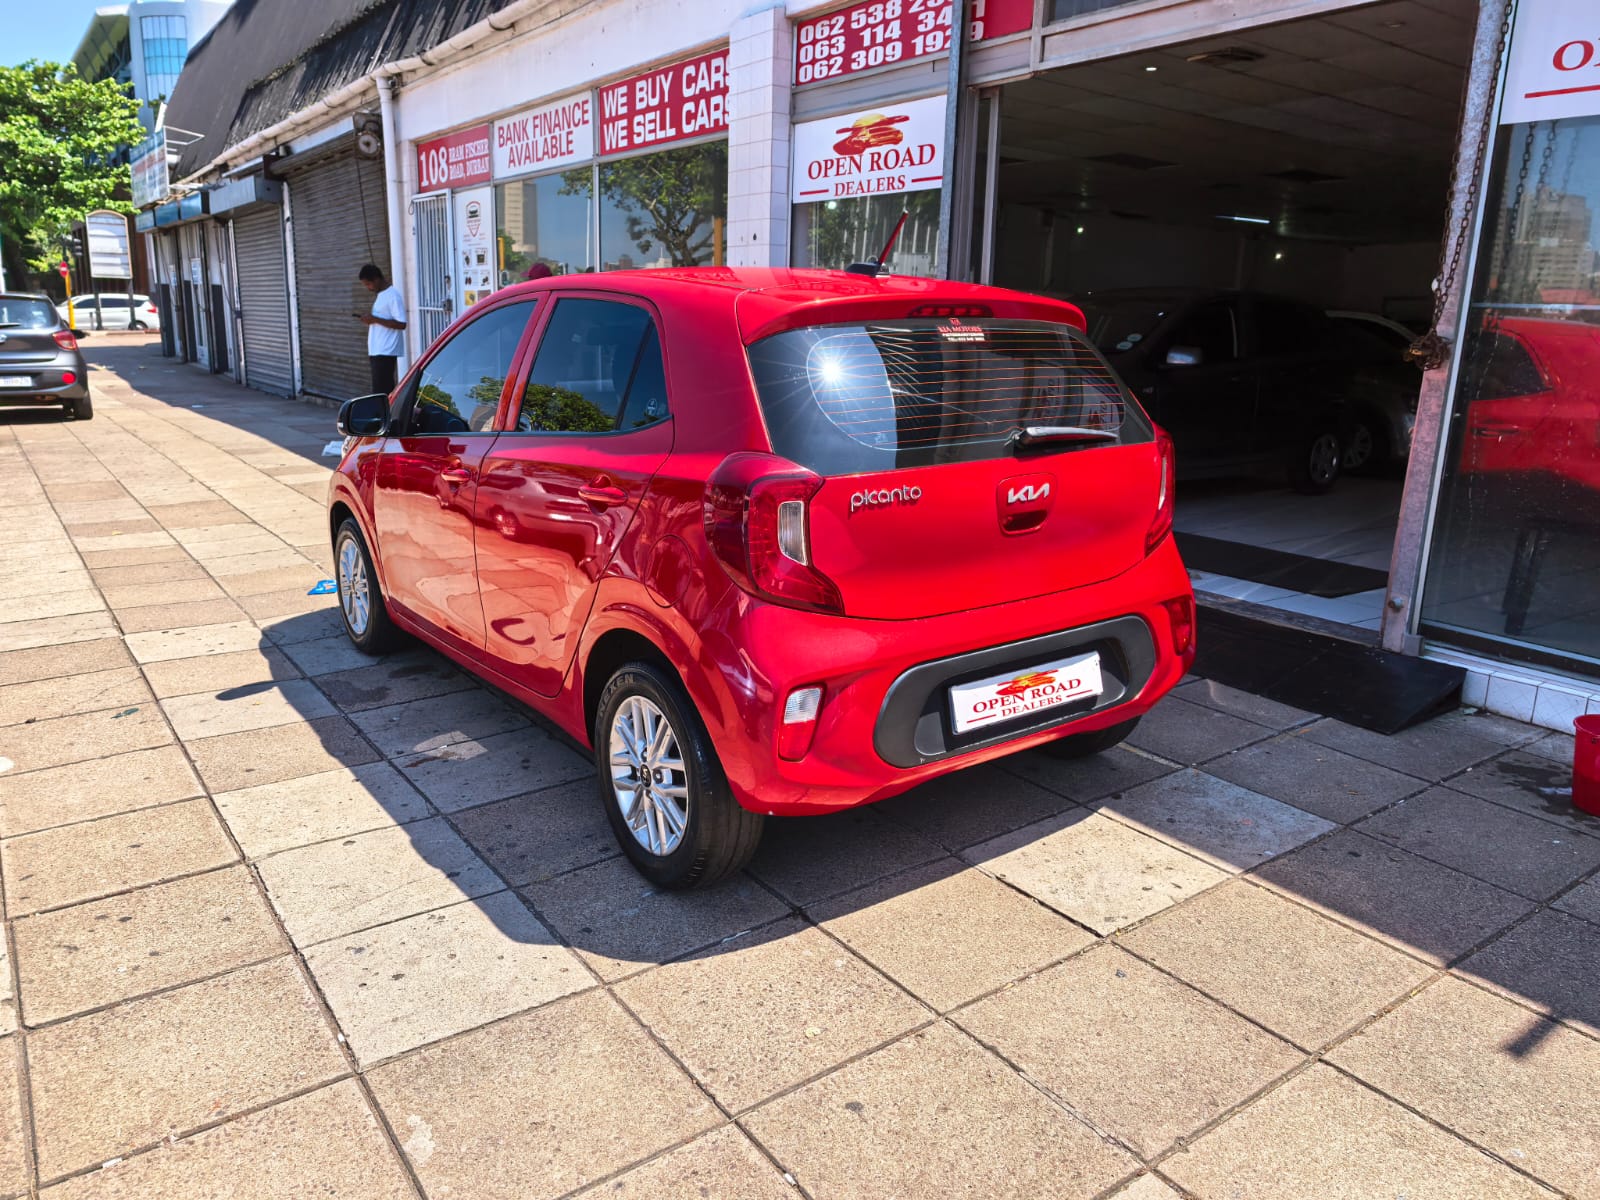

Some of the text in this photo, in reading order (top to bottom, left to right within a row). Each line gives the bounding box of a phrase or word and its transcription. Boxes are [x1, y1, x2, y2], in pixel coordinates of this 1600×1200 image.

[799, 35, 846, 64] 063
[860, 19, 902, 47] 114
[800, 15, 846, 45] 062
[850, 0, 902, 29] 538
[798, 56, 843, 83] 062
[851, 41, 902, 71] 309
[1552, 38, 1600, 71] O
[603, 85, 628, 119] WE
[635, 71, 674, 111] BUY
[497, 99, 590, 148] BANK FINANCE
[603, 118, 628, 151] WE
[633, 107, 676, 144] SELL
[419, 147, 448, 187] 108
[507, 130, 574, 169] AVAILABLE
[807, 143, 936, 180] OPEN ROAD
[834, 174, 906, 197] DEALERS
[850, 484, 922, 512] picanto
[973, 678, 1081, 713] OPEN ROAD
[1001, 694, 1063, 717] DEALERS
